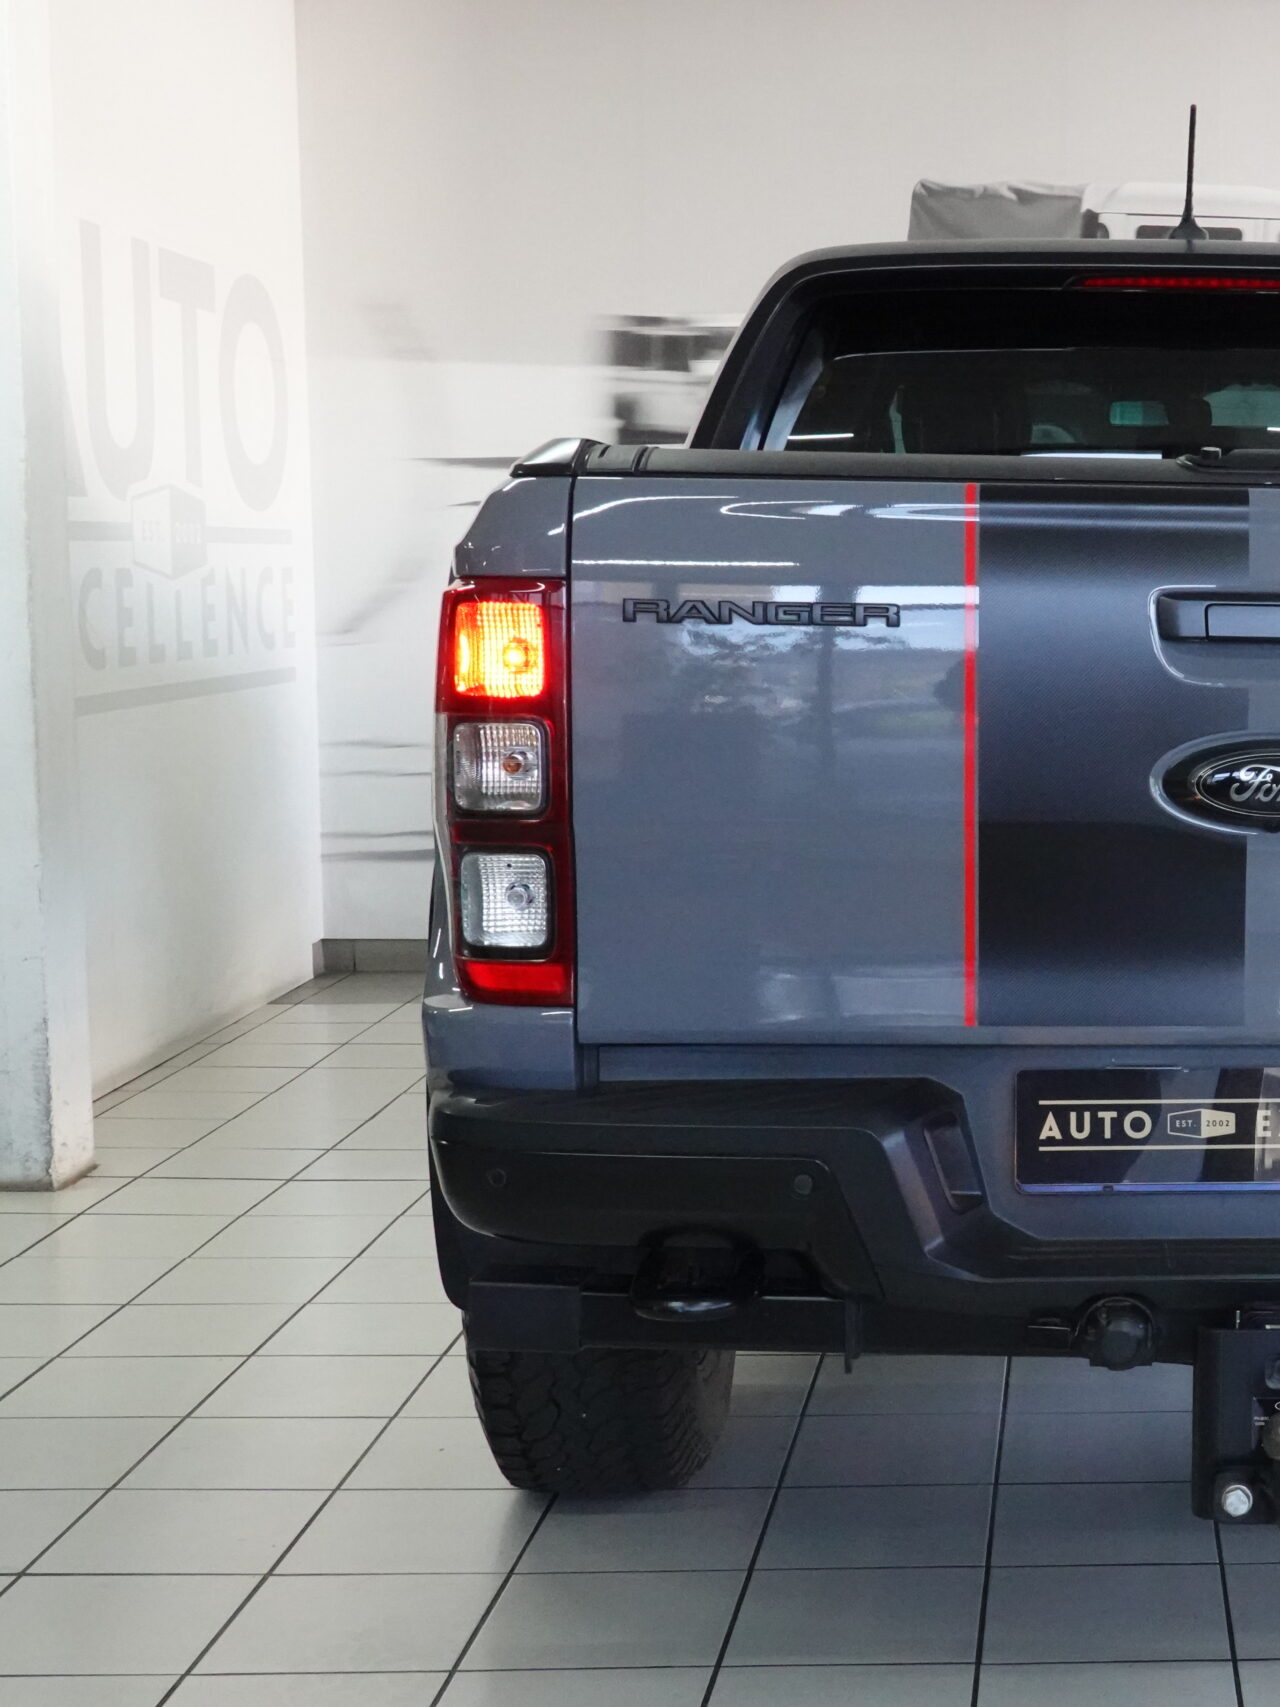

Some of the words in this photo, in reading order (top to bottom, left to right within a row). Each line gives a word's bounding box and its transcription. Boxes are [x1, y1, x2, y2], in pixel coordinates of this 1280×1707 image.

[77, 566, 296, 671] CELLENCE
[622, 597, 900, 628] RANGER
[1038, 1109, 1153, 1141] AUTO
[1175, 1119, 1198, 1128] EST.
[1206, 1119, 1231, 1128] 2002
